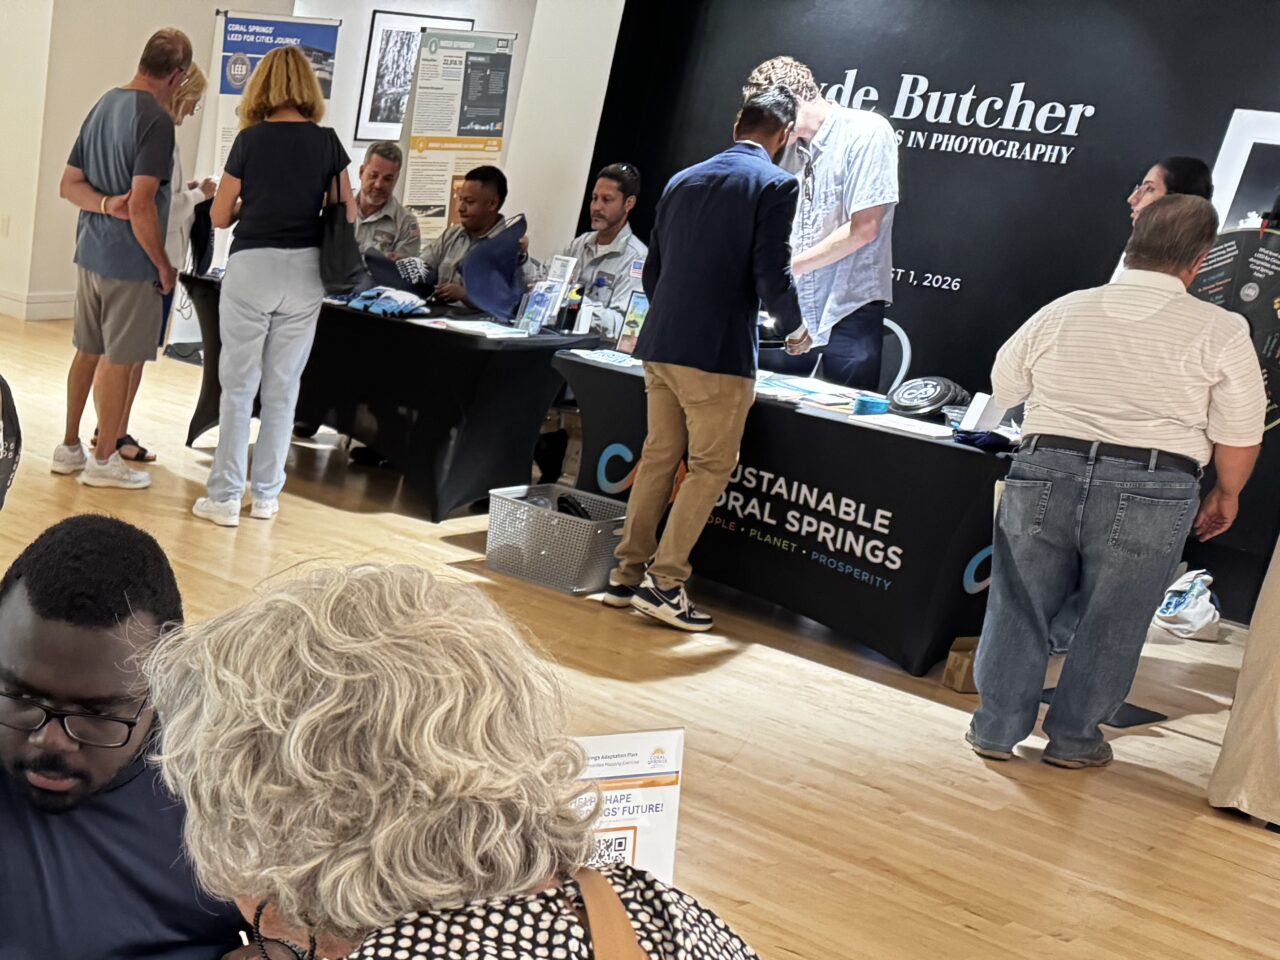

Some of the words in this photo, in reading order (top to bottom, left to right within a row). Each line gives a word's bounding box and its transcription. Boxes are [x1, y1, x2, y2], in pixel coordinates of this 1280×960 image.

[243, 34, 255, 42] FOR
[274, 37, 301, 45] JOURNEY
[890, 73, 1095, 136] Butcher
[906, 131, 929, 149] IN
[929, 133, 1075, 164] PHOTOGRAPHY
[922, 273, 962, 291] 2026
[728, 465, 893, 535] USTAINABLE
[749, 528, 798, 553] PLANET
[811, 551, 892, 591] PROSPERITY
[785, 510, 904, 570] SPRINGS
[621, 802, 664, 816] FUTURE!
